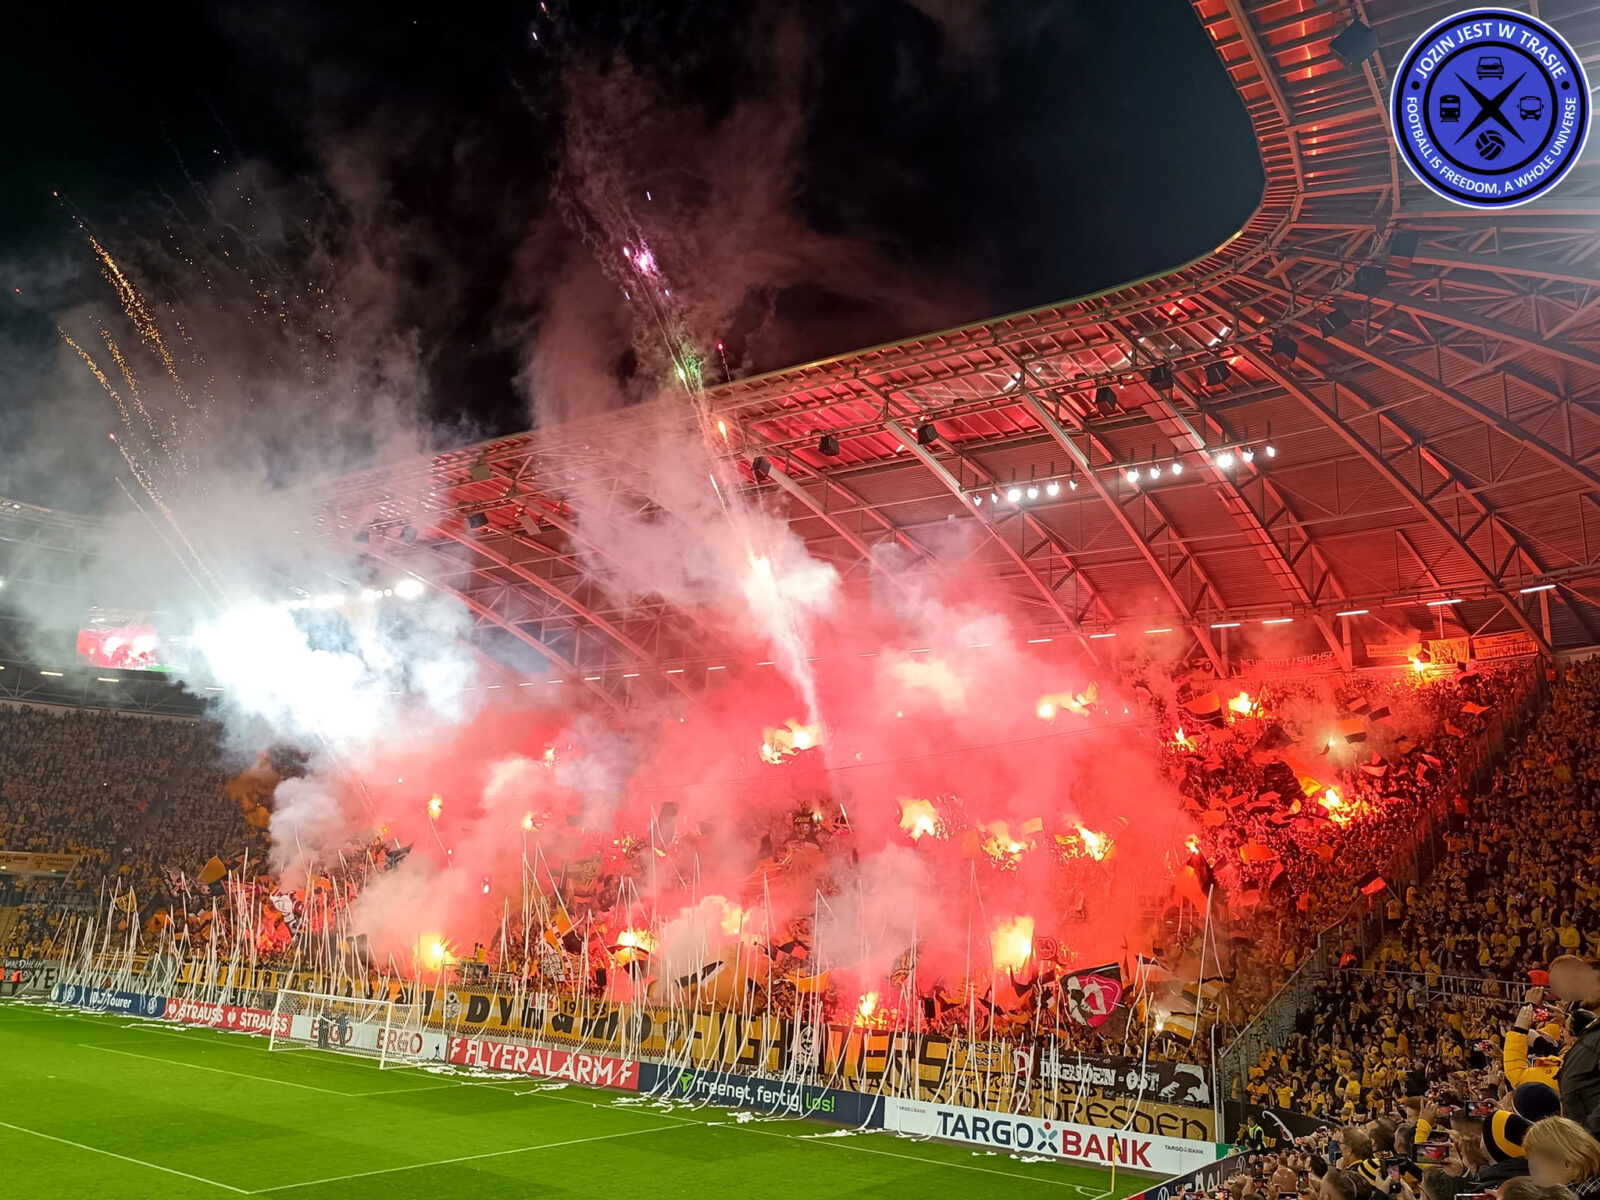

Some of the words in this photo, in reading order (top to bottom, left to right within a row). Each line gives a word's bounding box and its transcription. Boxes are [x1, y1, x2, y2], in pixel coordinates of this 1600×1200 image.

[106, 994, 133, 1009] Tourer
[563, 1000, 576, 1014] 19
[180, 1003, 224, 1023] STRAUSS
[240, 1012, 288, 1033] STRAUSS
[376, 1027, 423, 1054] ERGO
[464, 1039, 613, 1085] FLYERALARM
[756, 1085, 800, 1112] fertig
